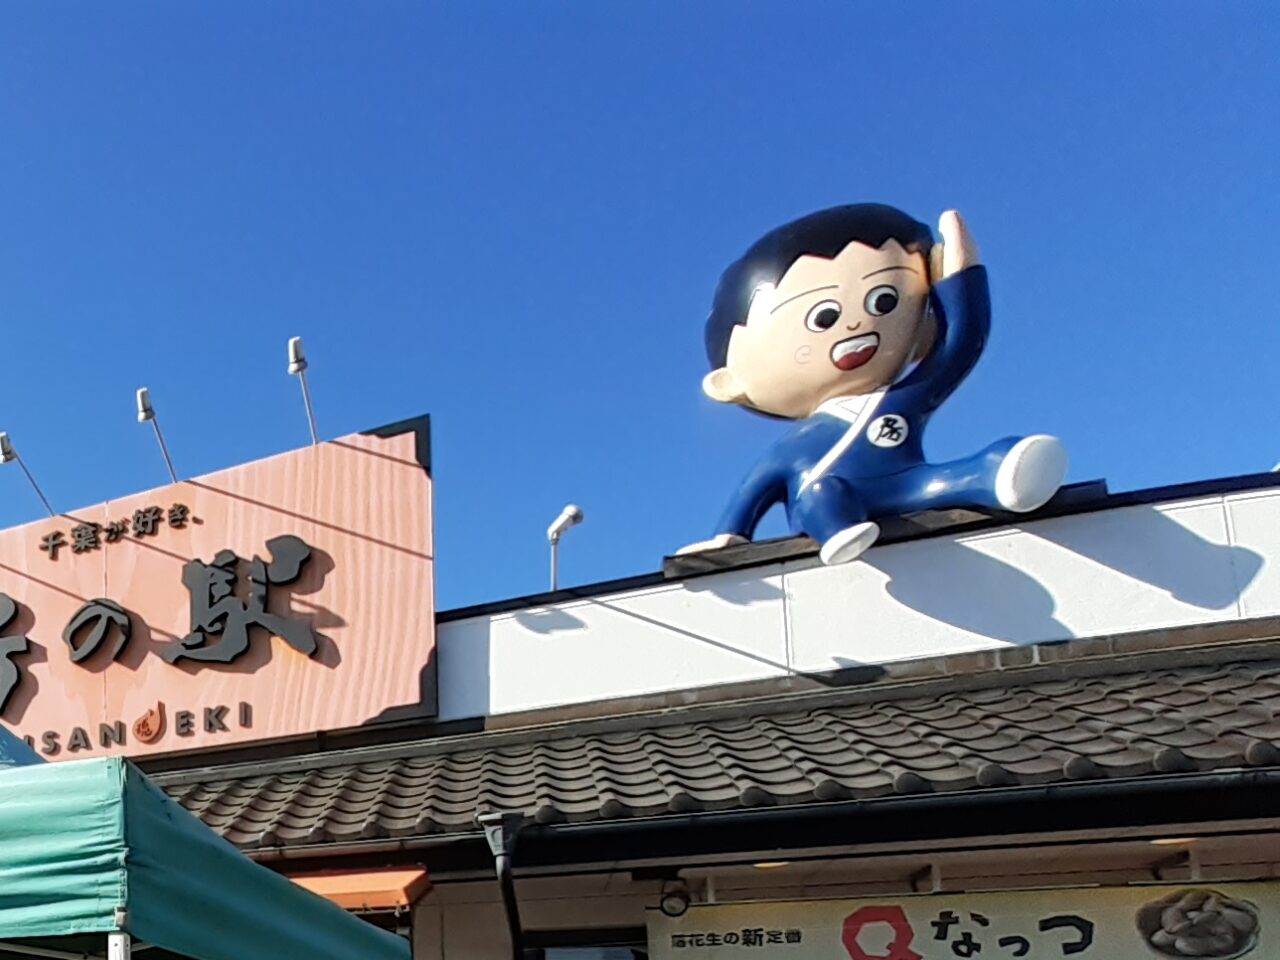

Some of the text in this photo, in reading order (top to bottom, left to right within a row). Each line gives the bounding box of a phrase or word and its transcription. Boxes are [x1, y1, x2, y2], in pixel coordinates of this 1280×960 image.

[39, 503, 204, 561] 千葉が好き、
[671, 928, 802, 948] 落花生の新定番
